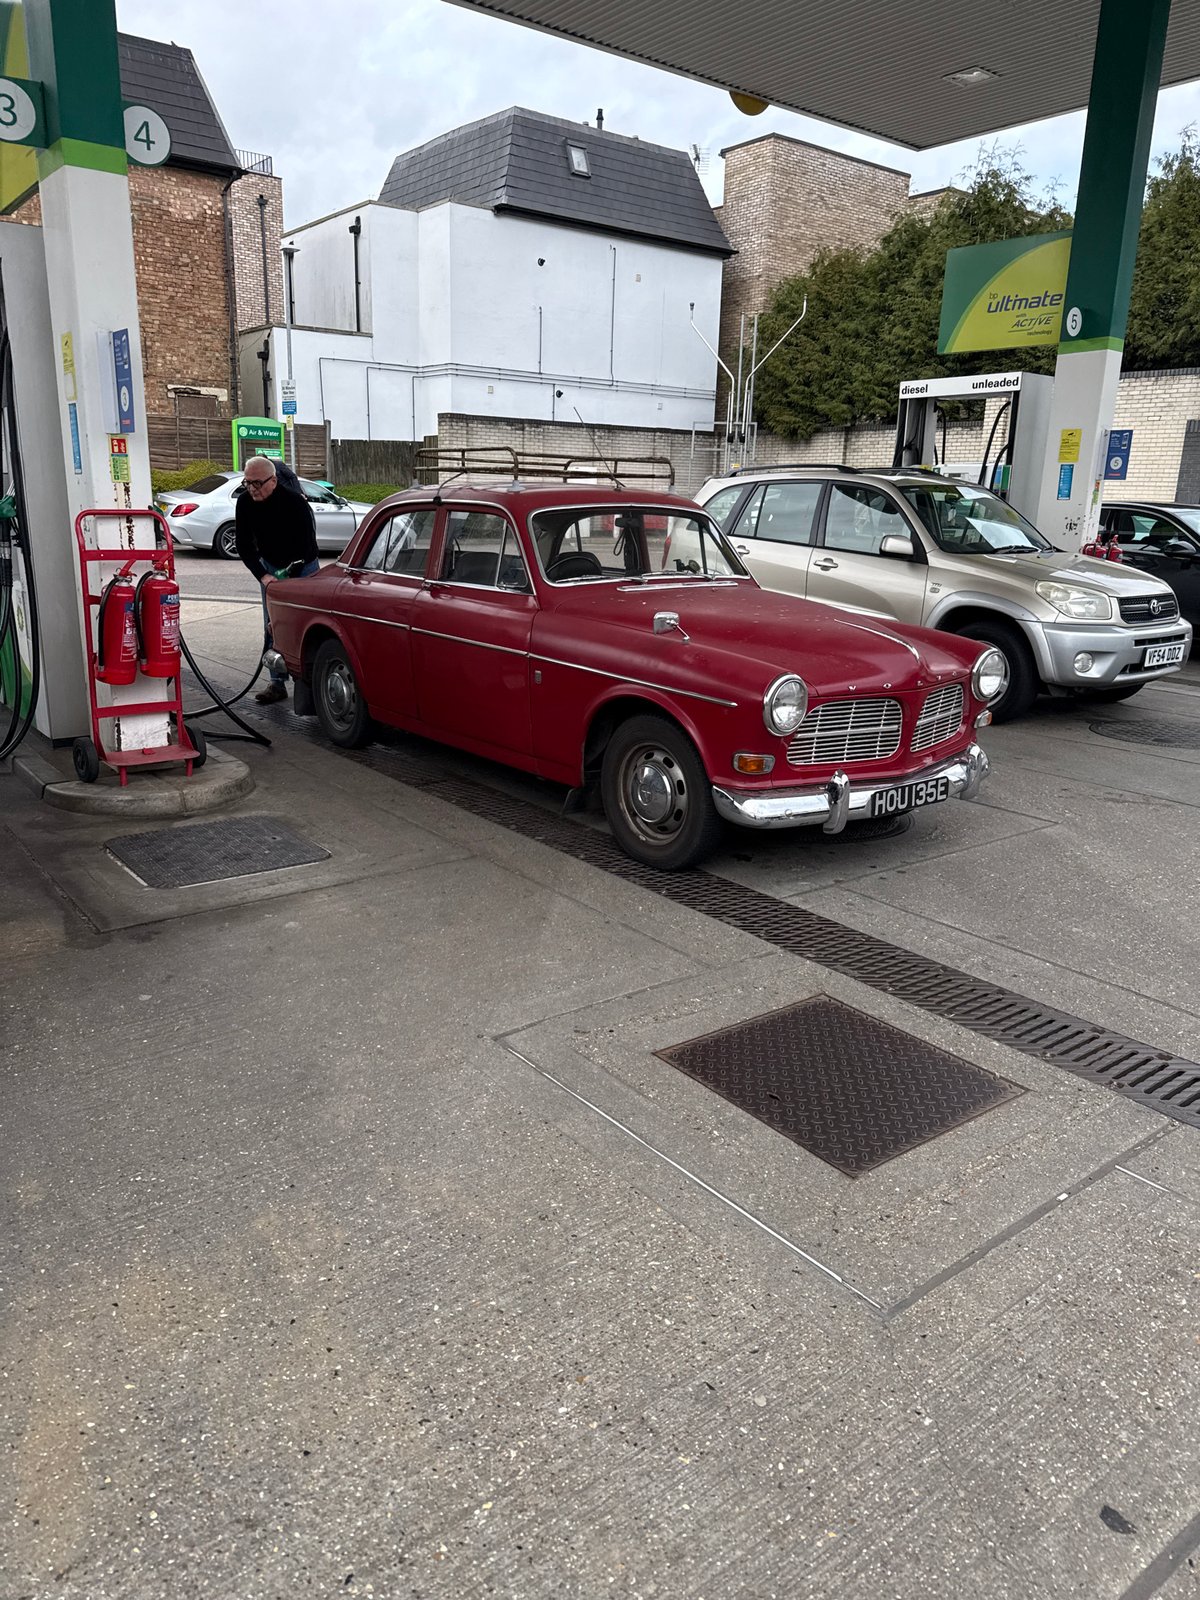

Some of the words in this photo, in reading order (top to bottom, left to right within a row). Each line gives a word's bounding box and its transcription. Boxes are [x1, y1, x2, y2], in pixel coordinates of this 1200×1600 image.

[0, 93, 17, 126] 3
[134, 121, 155, 151] 4
[987, 290, 1063, 313] ultimate
[989, 292, 998, 300] bp
[1011, 315, 1054, 328] ACTIVE
[1071, 314, 1077, 330] 5
[901, 384, 928, 395] diesel
[972, 377, 1019, 390] unleaded
[1113, 459, 1119, 468] 5
[874, 786, 909, 816] HOU
[911, 778, 948, 807] 135E
